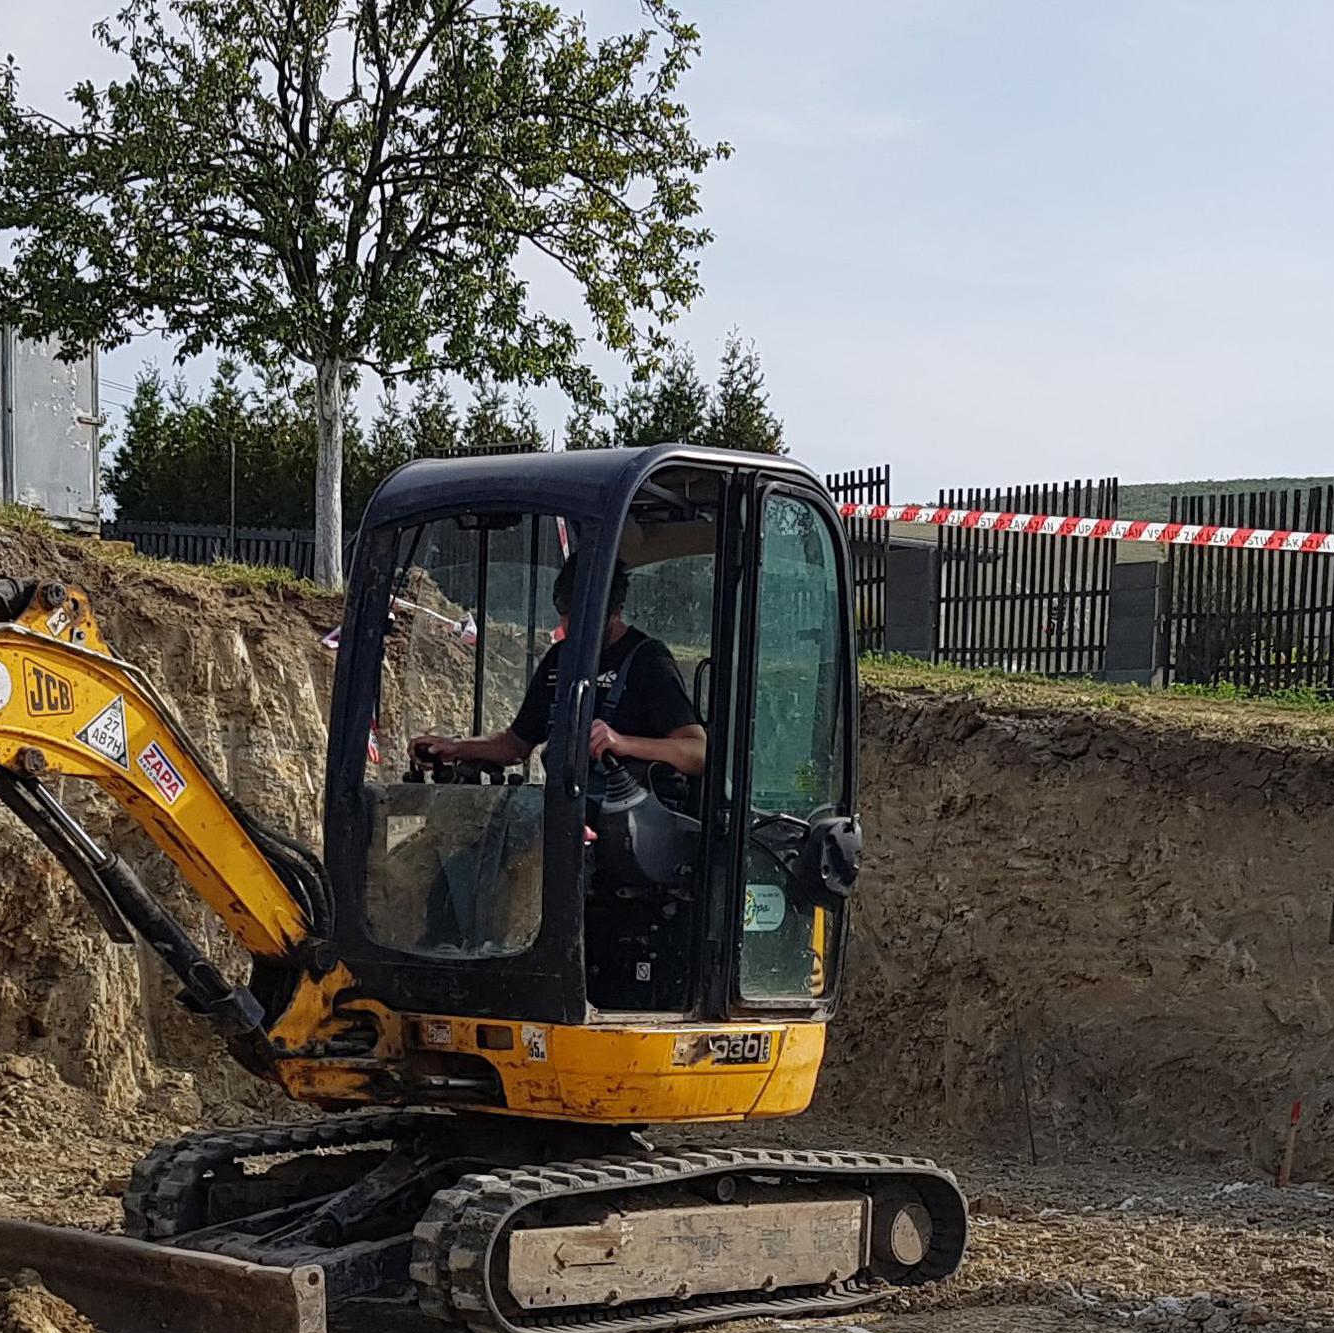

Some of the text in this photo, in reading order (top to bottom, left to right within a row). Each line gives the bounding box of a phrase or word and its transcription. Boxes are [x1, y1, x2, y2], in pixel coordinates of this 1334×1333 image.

[1058, 523, 1091, 534] VSTUP
[1093, 523, 1142, 537] ZAKÁZÁN
[1146, 528, 1180, 539] VSTUP
[1183, 529, 1234, 543] ZAKÁZÁN
[1239, 534, 1274, 546] VSTUP
[29, 666, 70, 711] JCB
[103, 716, 120, 733] 27
[91, 728, 122, 755] AB7H
[143, 748, 179, 798] ZAPA
